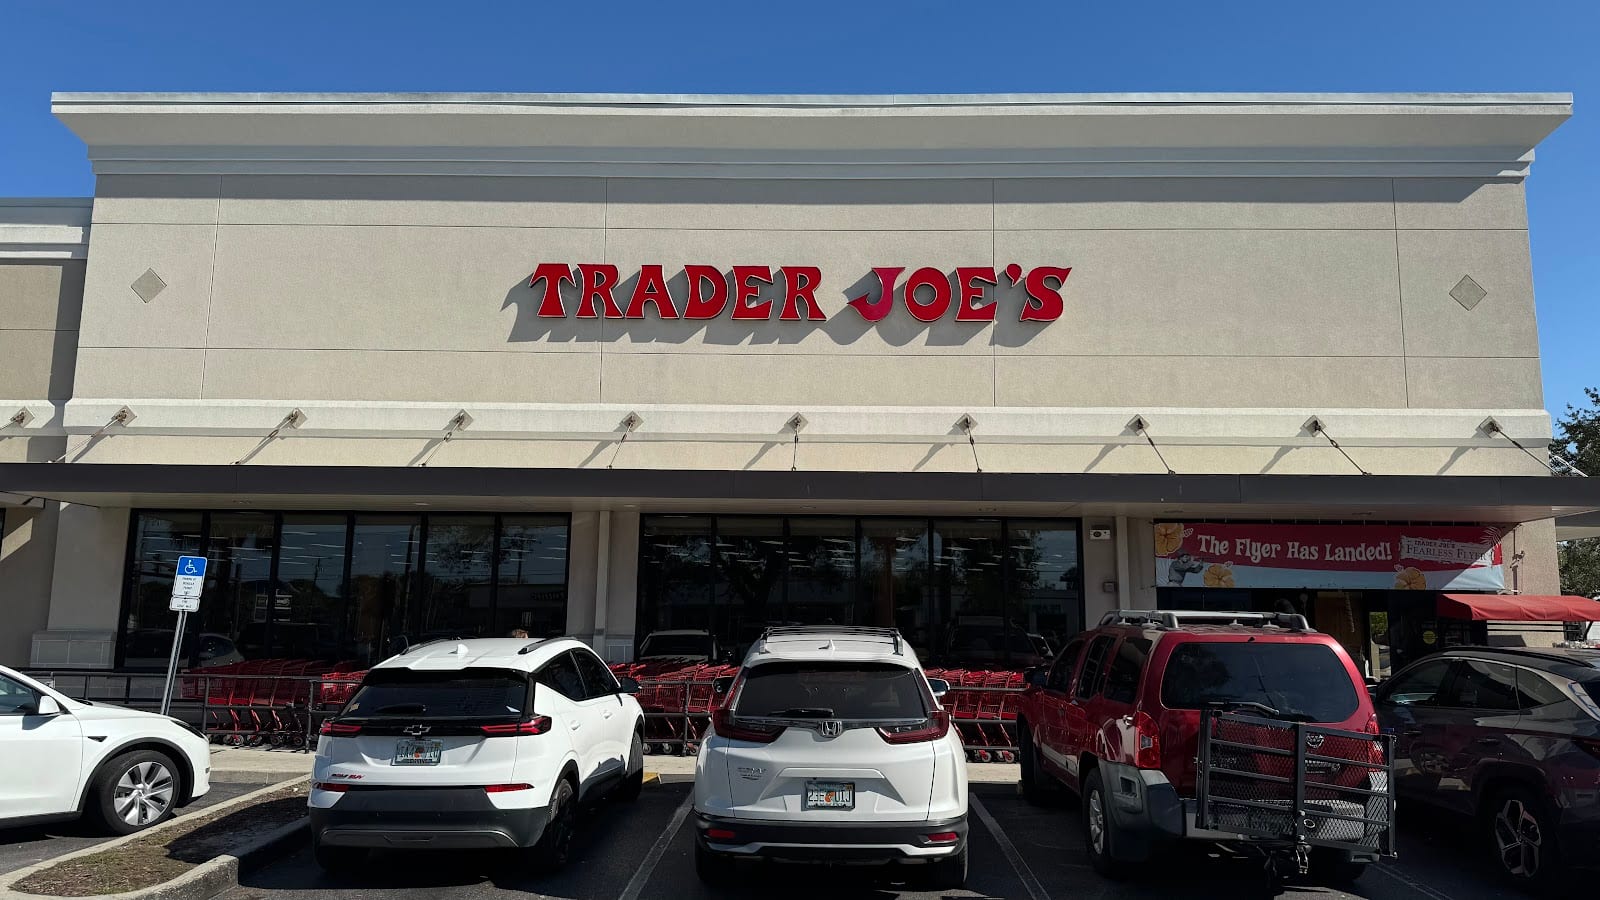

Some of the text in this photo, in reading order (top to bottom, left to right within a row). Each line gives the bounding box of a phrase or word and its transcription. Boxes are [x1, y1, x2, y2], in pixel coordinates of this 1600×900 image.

[529, 262, 1072, 323] TRADER JOE'S
[1198, 534, 1393, 563] The Flyer Has Landed!
[1407, 544, 1487, 561] FEARLESS FLYER
